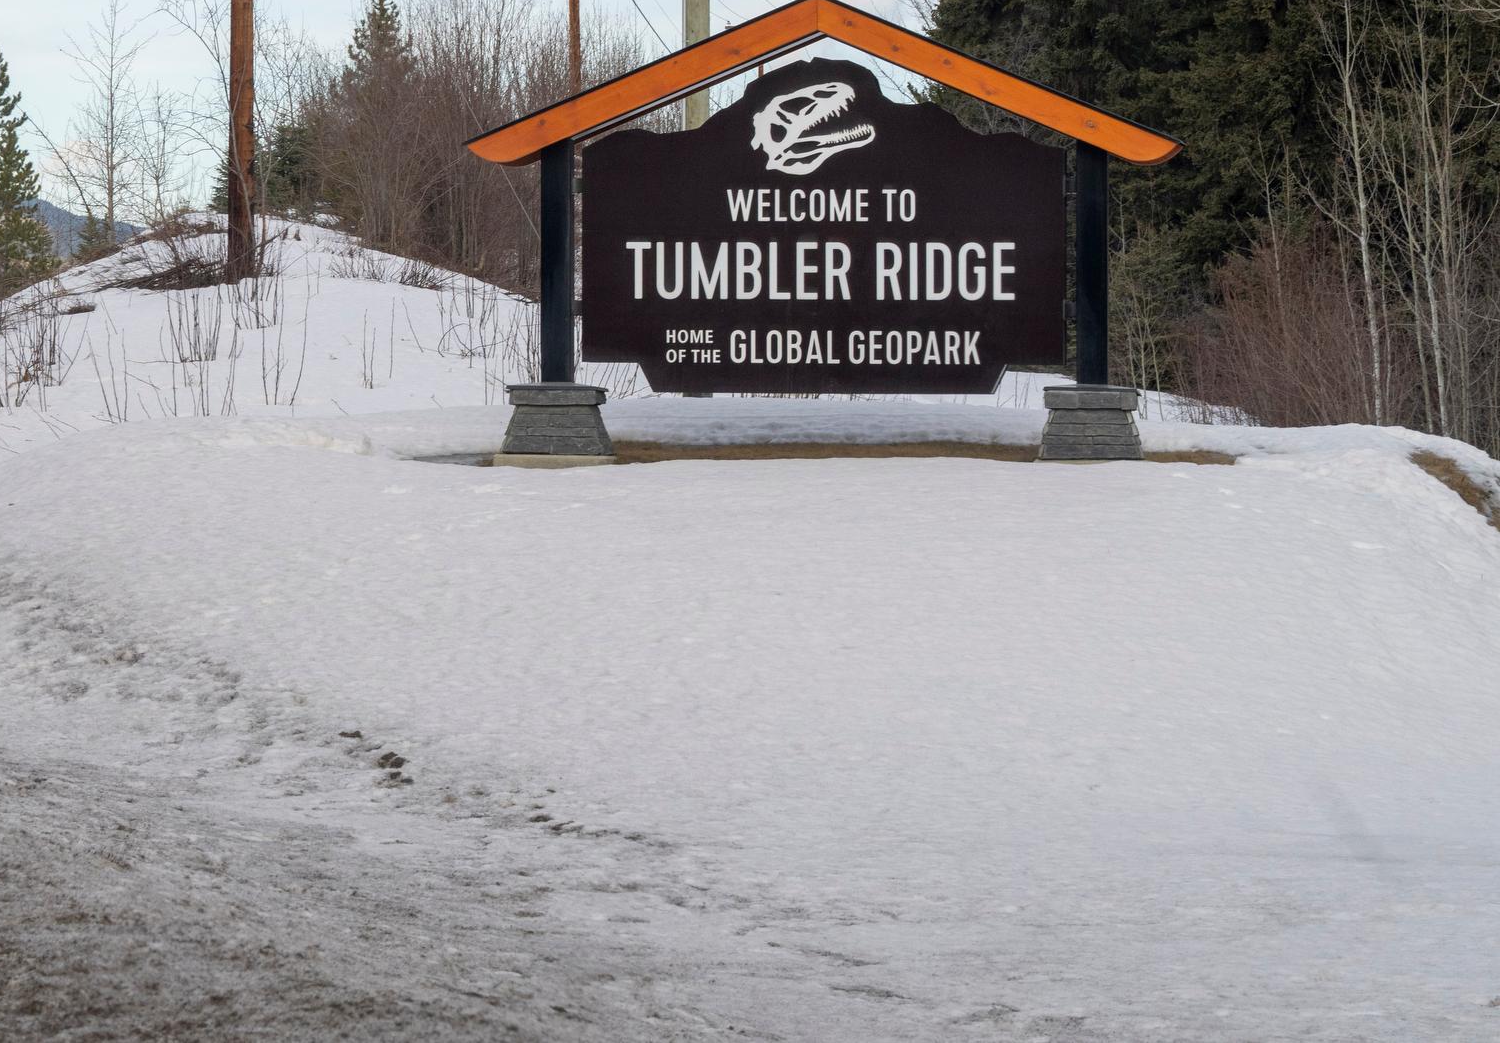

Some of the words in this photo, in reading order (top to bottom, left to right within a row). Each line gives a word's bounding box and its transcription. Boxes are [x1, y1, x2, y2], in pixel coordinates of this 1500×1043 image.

[726, 188, 869, 222] WELCOME
[881, 188, 916, 223] TO
[625, 241, 852, 301] TUMBLER
[875, 241, 1016, 301] RIDGE
[665, 329, 714, 344] HOME
[729, 329, 841, 365] GLOBAL
[848, 330, 981, 365] GEOPARK
[665, 348, 687, 364] OF
[690, 349, 721, 364] THE
